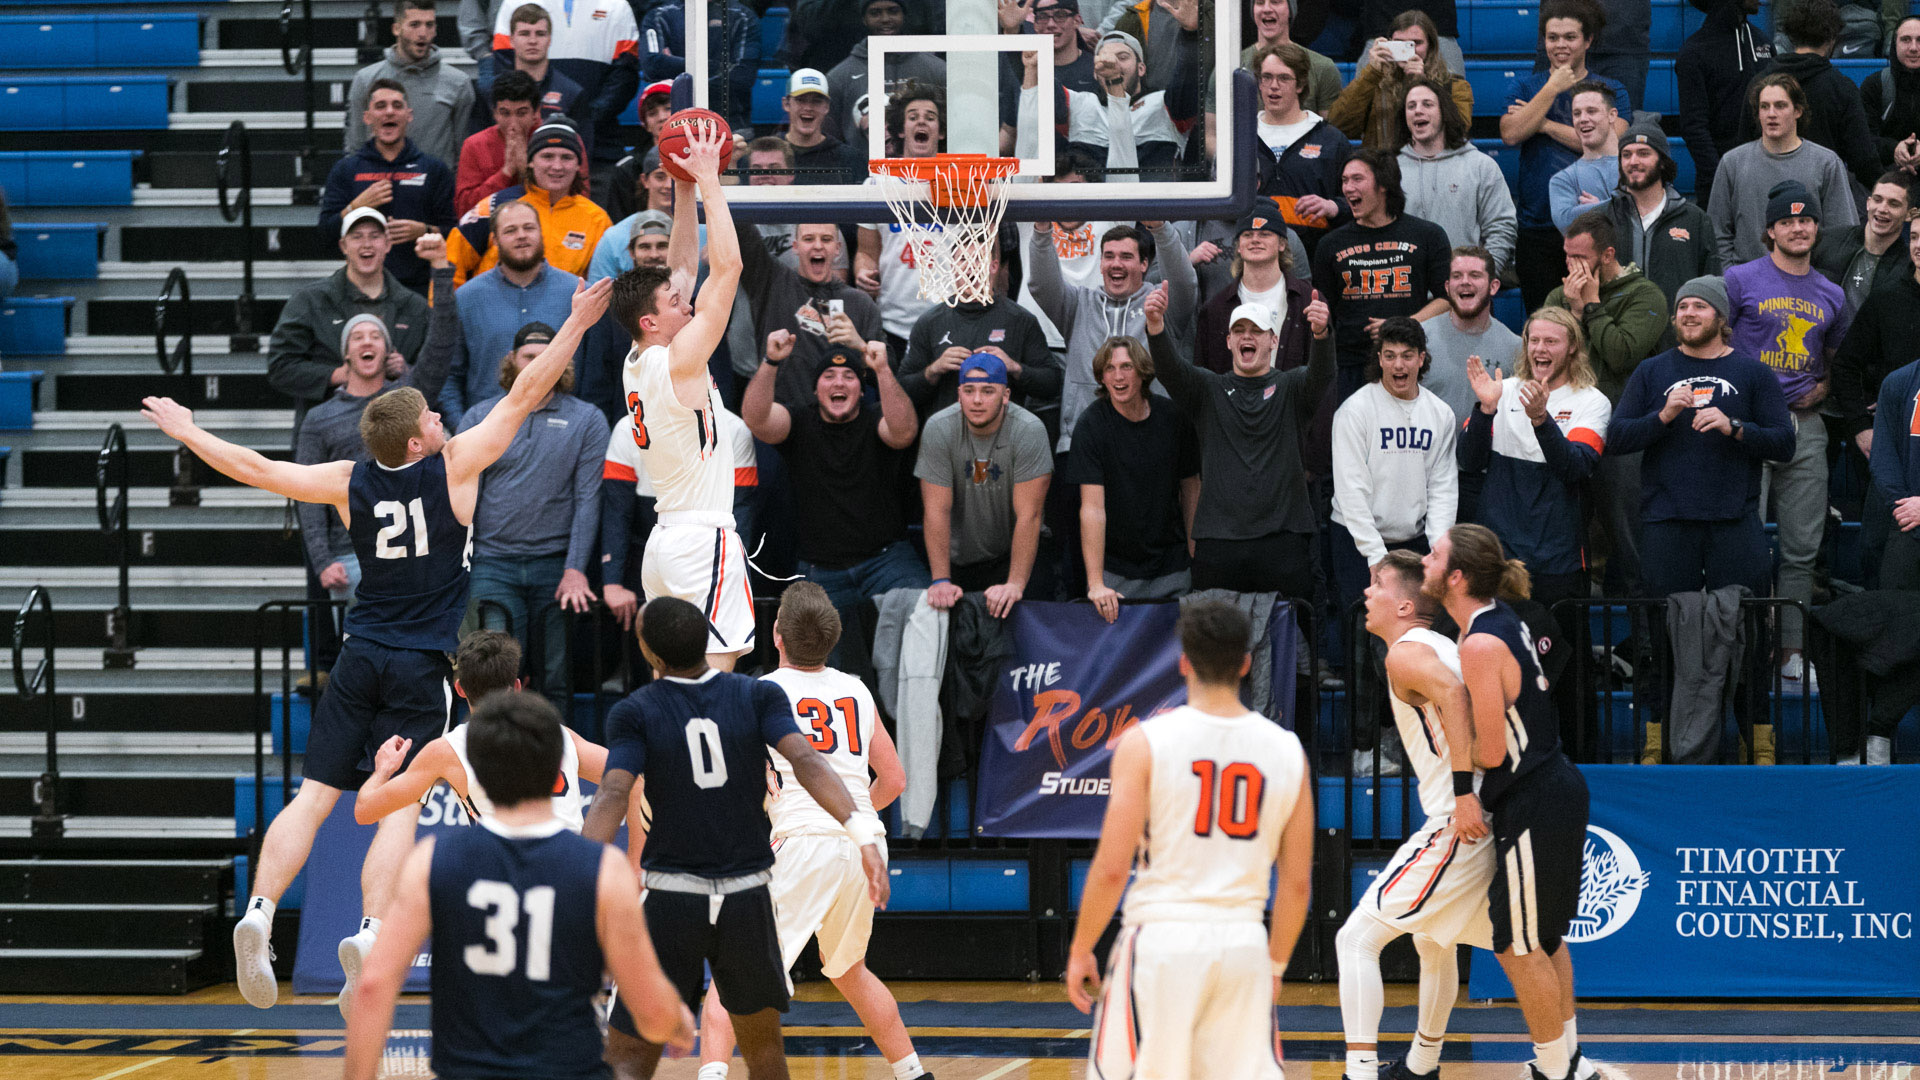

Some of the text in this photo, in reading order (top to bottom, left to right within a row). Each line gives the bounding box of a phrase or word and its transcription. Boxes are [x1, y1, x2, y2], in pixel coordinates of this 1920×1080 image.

[268, 229, 281, 250] K
[1336, 241, 1418, 262] JESUS CHRIST
[1348, 254, 1404, 267] Philippians 1:21
[1341, 265, 1412, 295] LIFE
[1758, 296, 1825, 323] MINNESOTA
[207, 376, 219, 399] H
[628, 391, 651, 450] 3
[1380, 426, 1433, 451] POLO
[374, 497, 429, 560] 21
[142, 532, 154, 554] F
[1010, 662, 1062, 694] THE
[73, 697, 85, 719] D
[797, 697, 862, 756] 31
[685, 717, 728, 789] 0
[1038, 771, 1113, 795] STUDE
[1192, 759, 1266, 840] 10
[1675, 847, 1846, 875] TIMOTHY
[1675, 880, 1865, 907] FINANCIAL
[463, 879, 556, 982] 31
[1675, 911, 1912, 943] COUNSEL, INC
